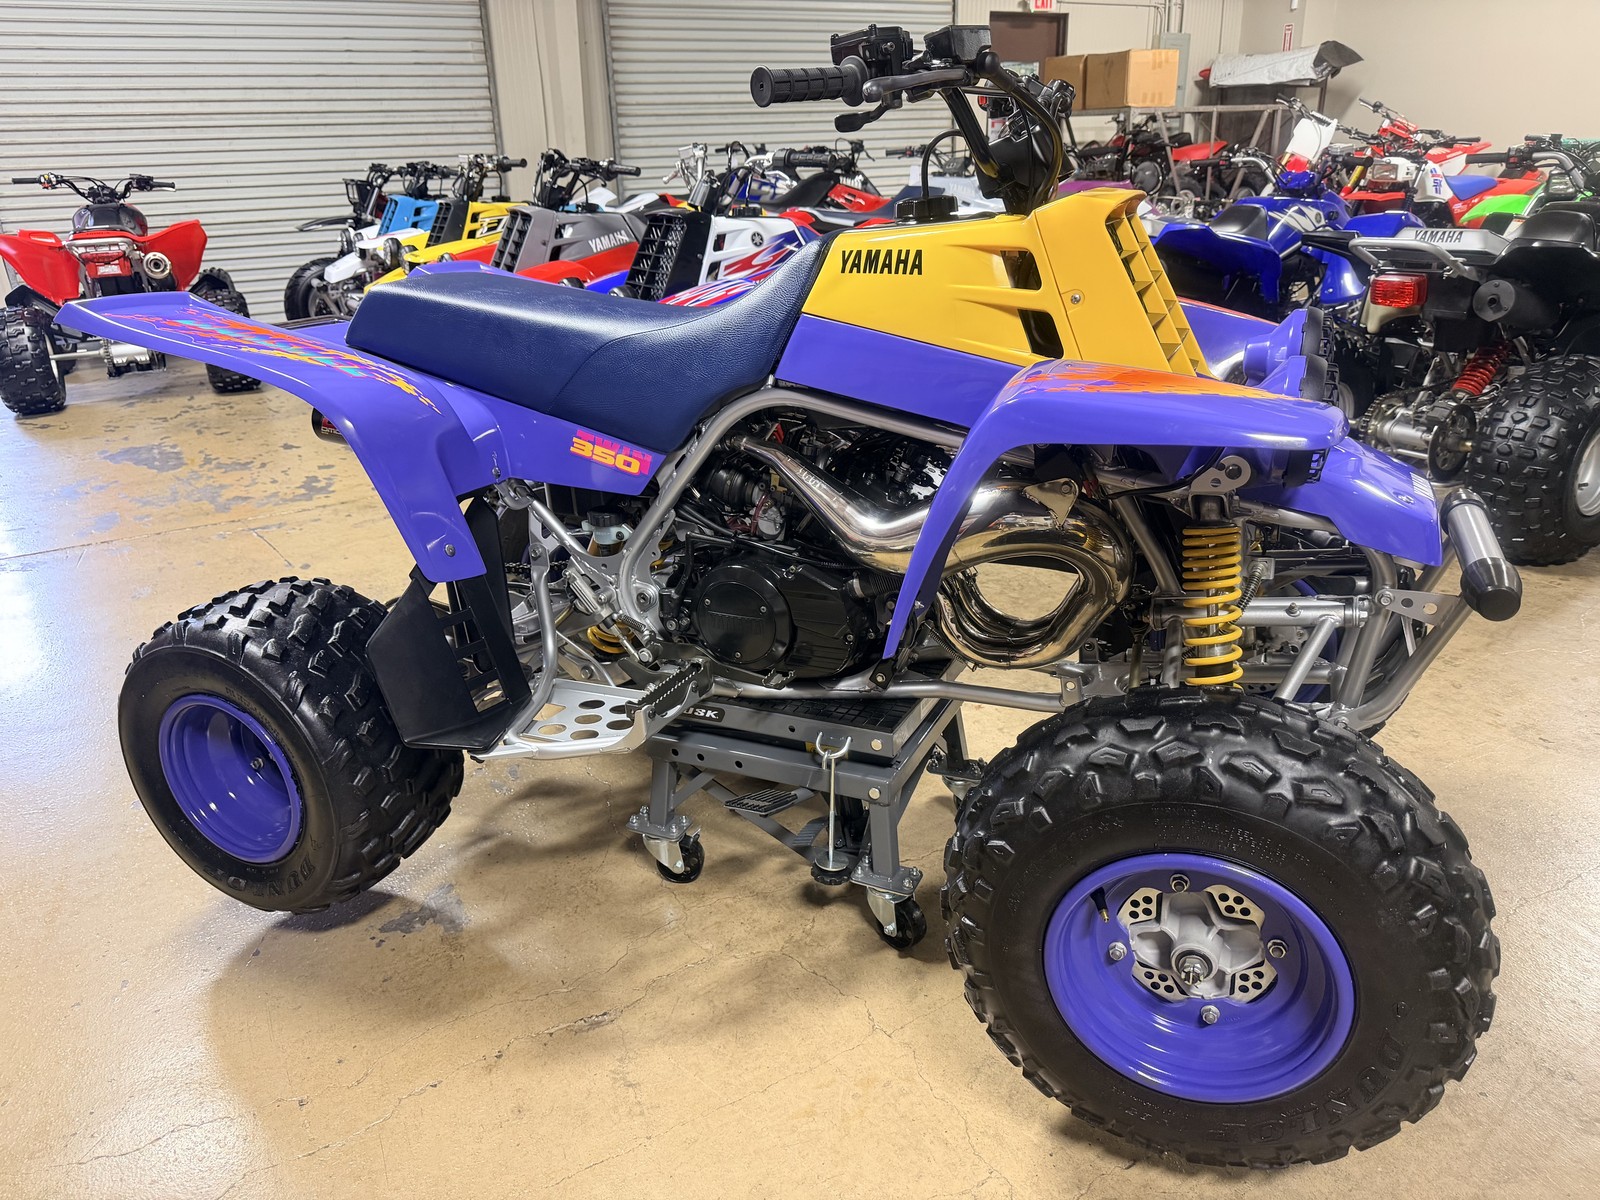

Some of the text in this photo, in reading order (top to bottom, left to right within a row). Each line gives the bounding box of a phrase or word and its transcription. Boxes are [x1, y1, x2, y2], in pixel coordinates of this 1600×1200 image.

[1034, 0, 1053, 9] EXIT
[589, 229, 631, 254] YAMAHA
[1413, 229, 1464, 243] YAMAHA
[840, 248, 924, 276] YAMAHA
[569, 436, 642, 476] 350
[683, 706, 719, 719] USK
